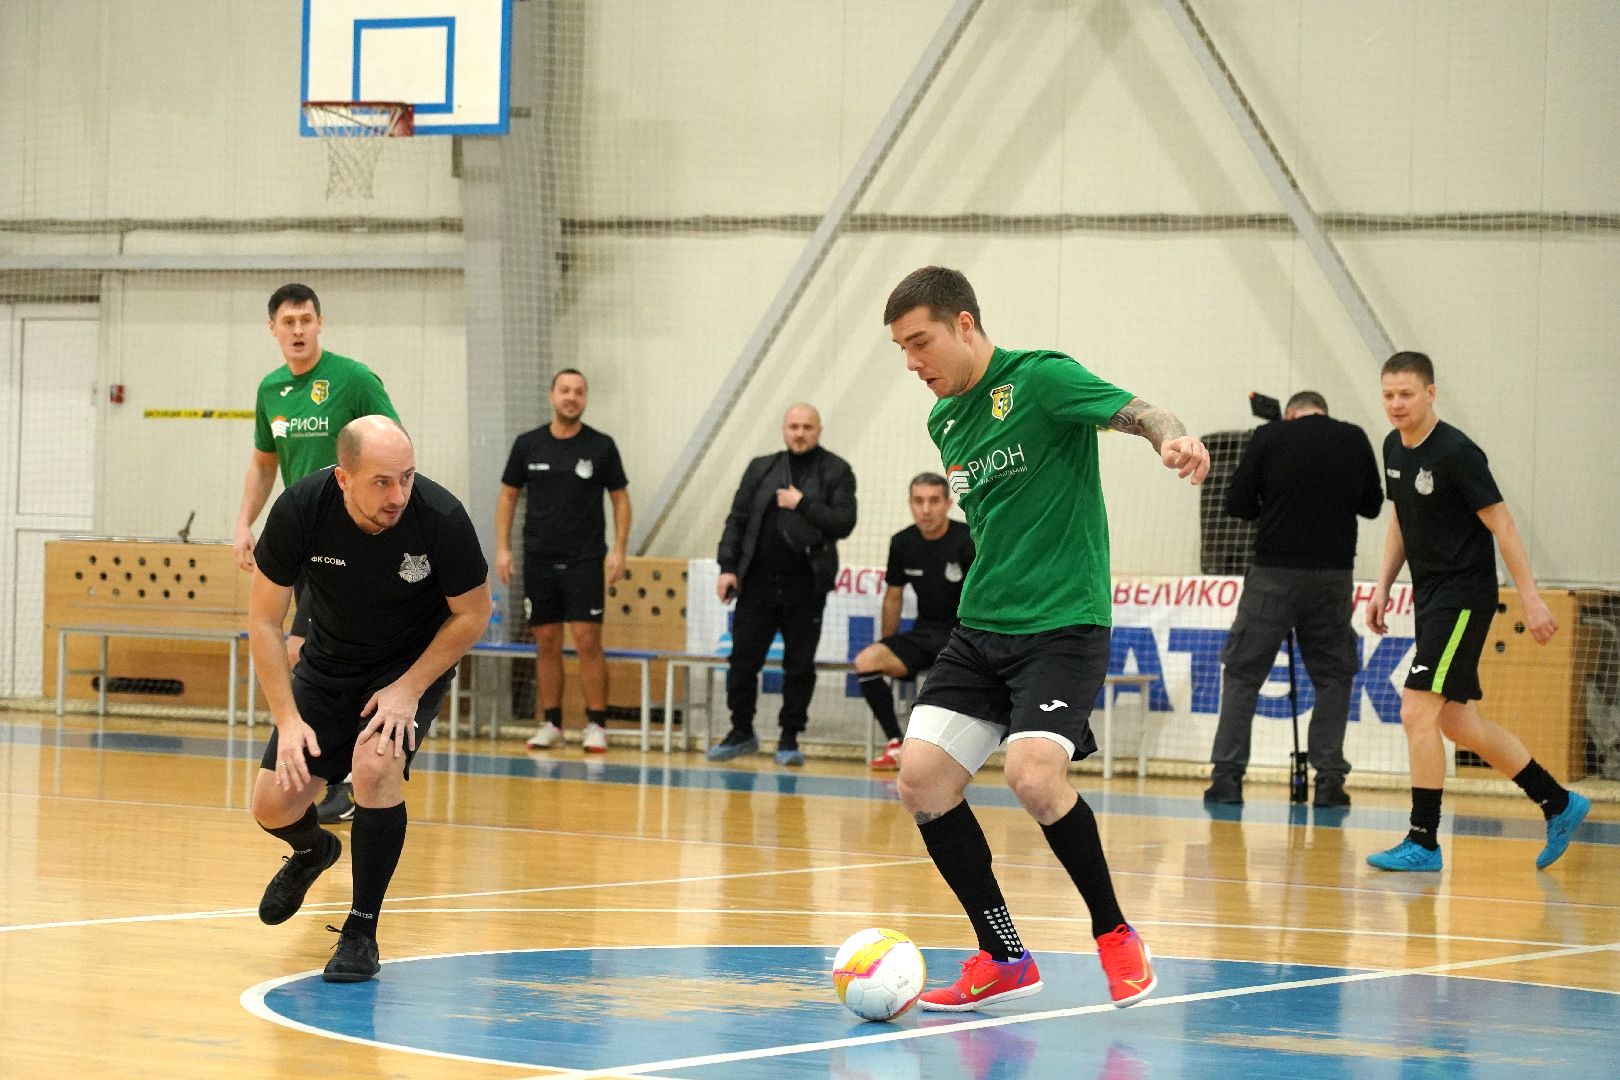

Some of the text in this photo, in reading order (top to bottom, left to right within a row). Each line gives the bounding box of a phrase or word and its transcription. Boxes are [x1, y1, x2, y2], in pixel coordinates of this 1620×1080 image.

[290, 416, 329, 432] РИОН
[967, 443, 1025, 480] РИОН
[324, 557, 347, 567] СОВА
[834, 566, 887, 595] АСТ
[1112, 579, 1239, 608] ВЕЛИКО
